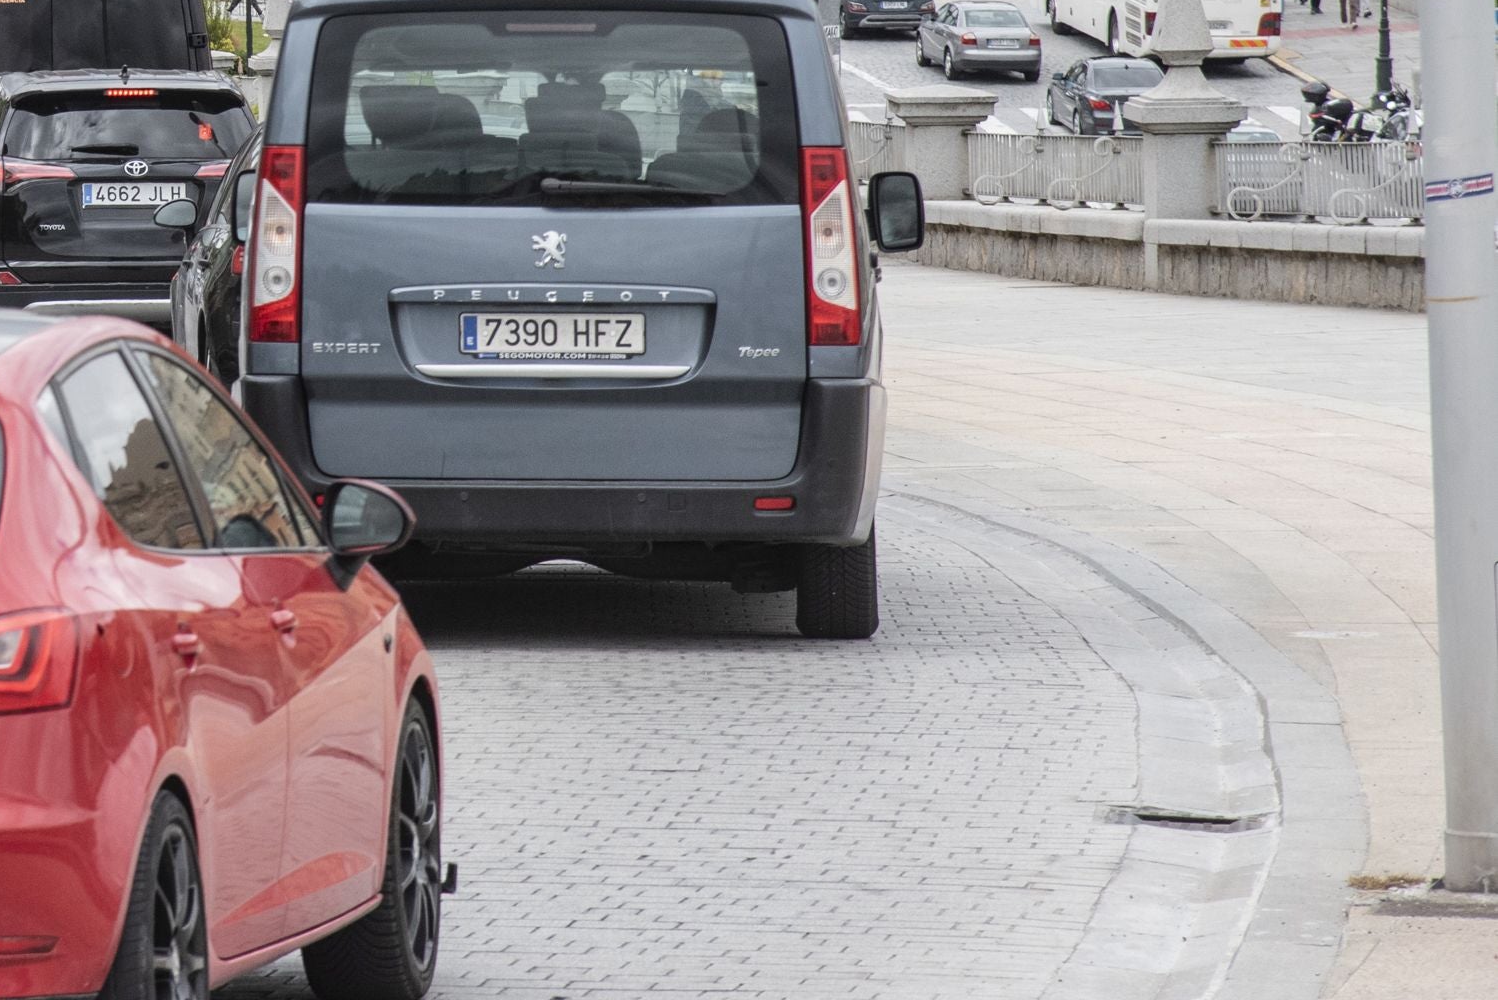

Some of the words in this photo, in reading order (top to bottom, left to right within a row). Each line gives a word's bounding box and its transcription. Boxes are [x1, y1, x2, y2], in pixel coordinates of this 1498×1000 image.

[96, 186, 141, 202] 4662
[148, 186, 182, 201] JLH
[433, 290, 671, 303] PEUGEOT
[484, 318, 559, 348] 7390
[572, 319, 634, 348] HFZ
[312, 342, 382, 354] EXPERT
[738, 346, 781, 359] Tepee
